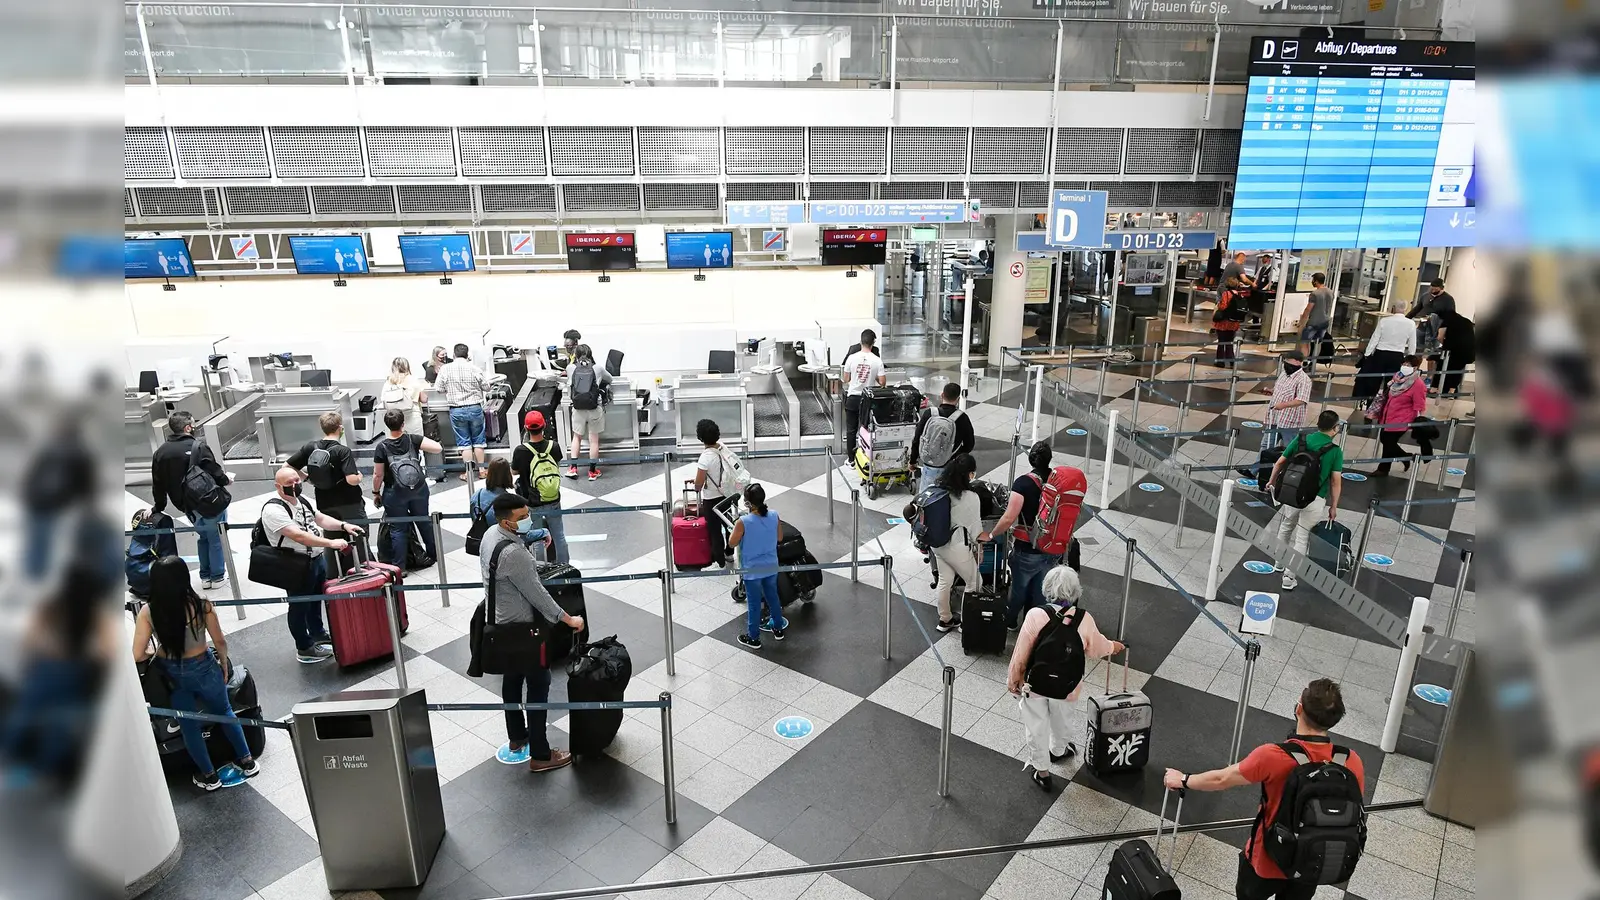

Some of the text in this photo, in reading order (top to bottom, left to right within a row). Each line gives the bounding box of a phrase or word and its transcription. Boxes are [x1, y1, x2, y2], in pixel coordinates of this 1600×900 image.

[1130, 0, 1231, 14] Wir bauen für Sie.
[1262, 39, 1275, 60] D
[1315, 41, 1344, 55] Abflug
[1351, 43, 1398, 56] Departures
[1423, 45, 1448, 56] 10:04
[1059, 194, 1087, 203] Terminal
[1056, 208, 1079, 242] D
[1122, 234, 1132, 248] D
[1168, 233, 1184, 248] 23
[1249, 600, 1274, 610] Ausgang
[1254, 607, 1266, 615] Exit
[342, 754, 365, 762] Abfall
